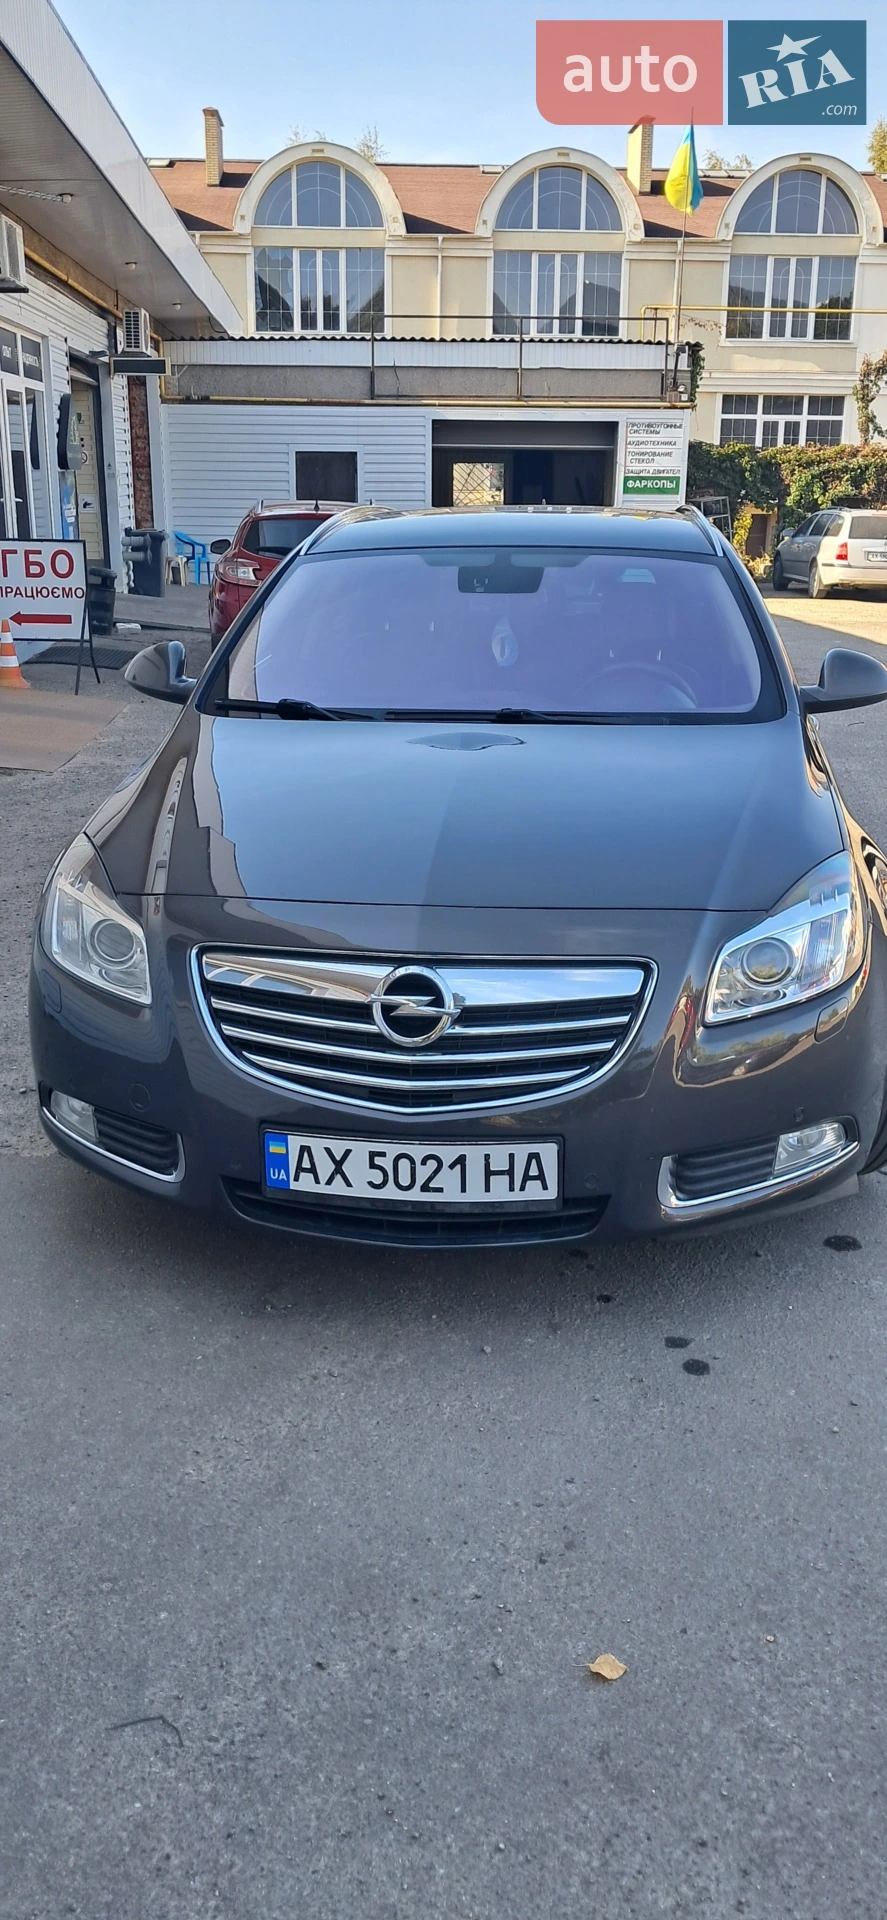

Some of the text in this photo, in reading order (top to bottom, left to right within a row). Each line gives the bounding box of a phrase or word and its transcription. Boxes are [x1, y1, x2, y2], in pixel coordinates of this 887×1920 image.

[626, 480, 676, 489] ФАРКОПЫ
[1, 549, 75, 579] ГБО
[270, 1167, 288, 1182] UA
[293, 1144, 549, 1194] AX 5021 HA
